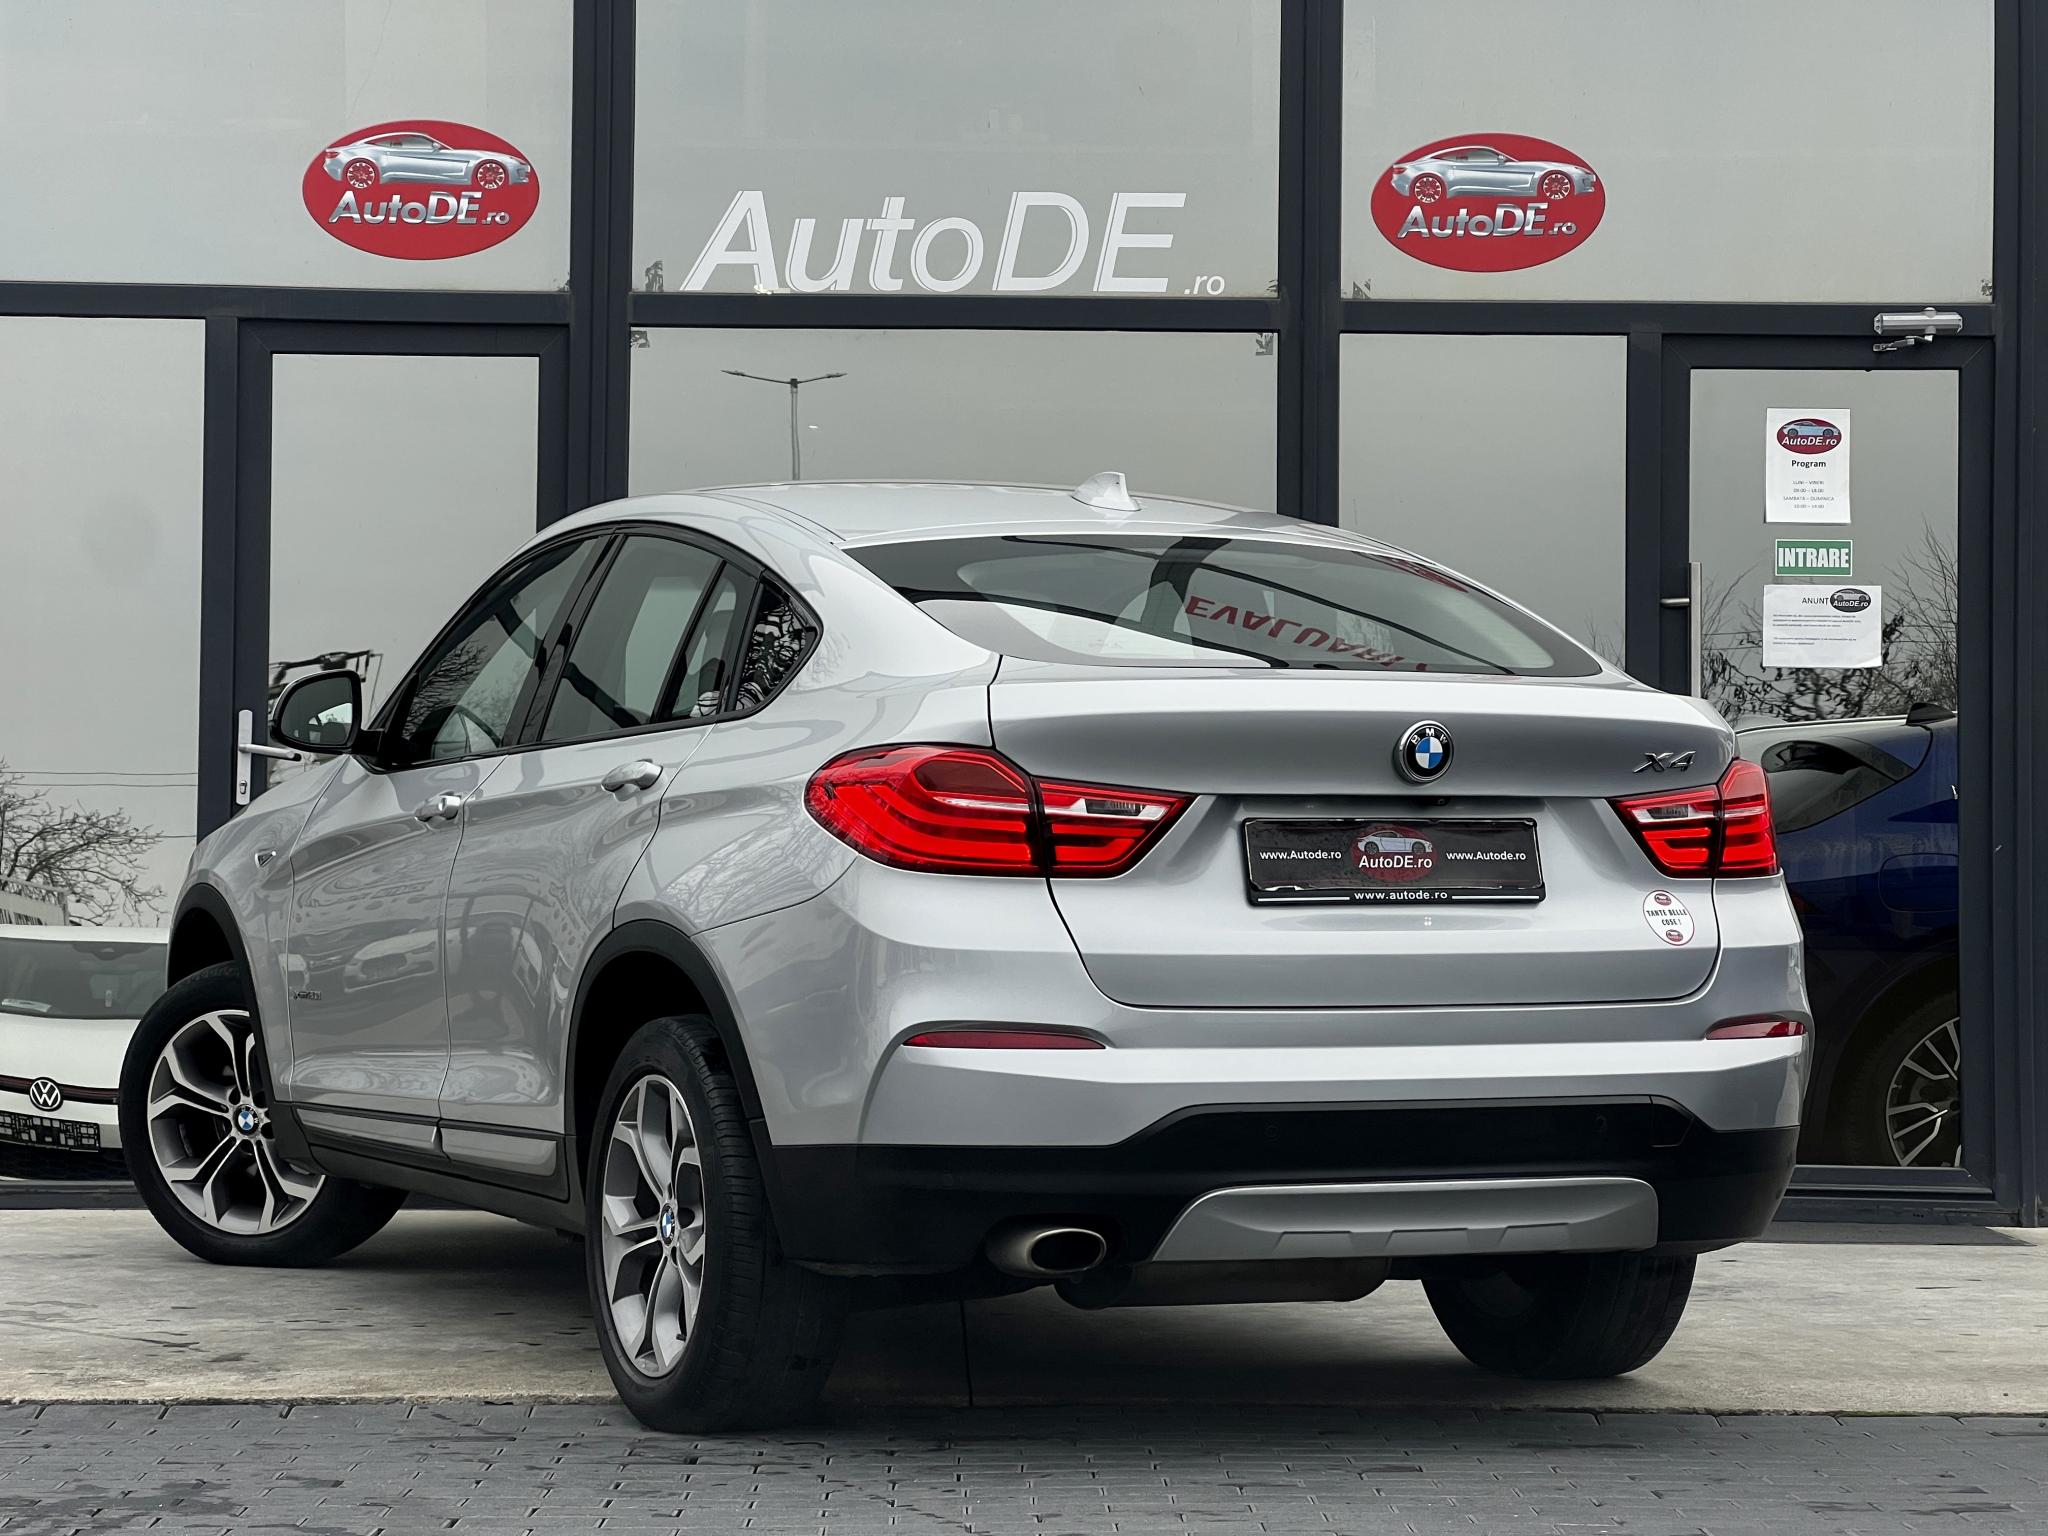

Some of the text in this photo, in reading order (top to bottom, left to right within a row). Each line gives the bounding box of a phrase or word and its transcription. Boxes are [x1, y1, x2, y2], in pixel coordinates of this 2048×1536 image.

[1781, 436, 1837, 446] AutoDE.ro
[1791, 460, 1827, 468] Program
[1778, 547, 1849, 568] INTRARE
[1632, 750, 1697, 773] X4
[1260, 850, 1342, 860] www.Autode.ro
[1446, 851, 1526, 861] www.Autode.ro
[1359, 855, 1432, 868] AutoDE.ro
[1354, 890, 1448, 900] www.autode.ro
